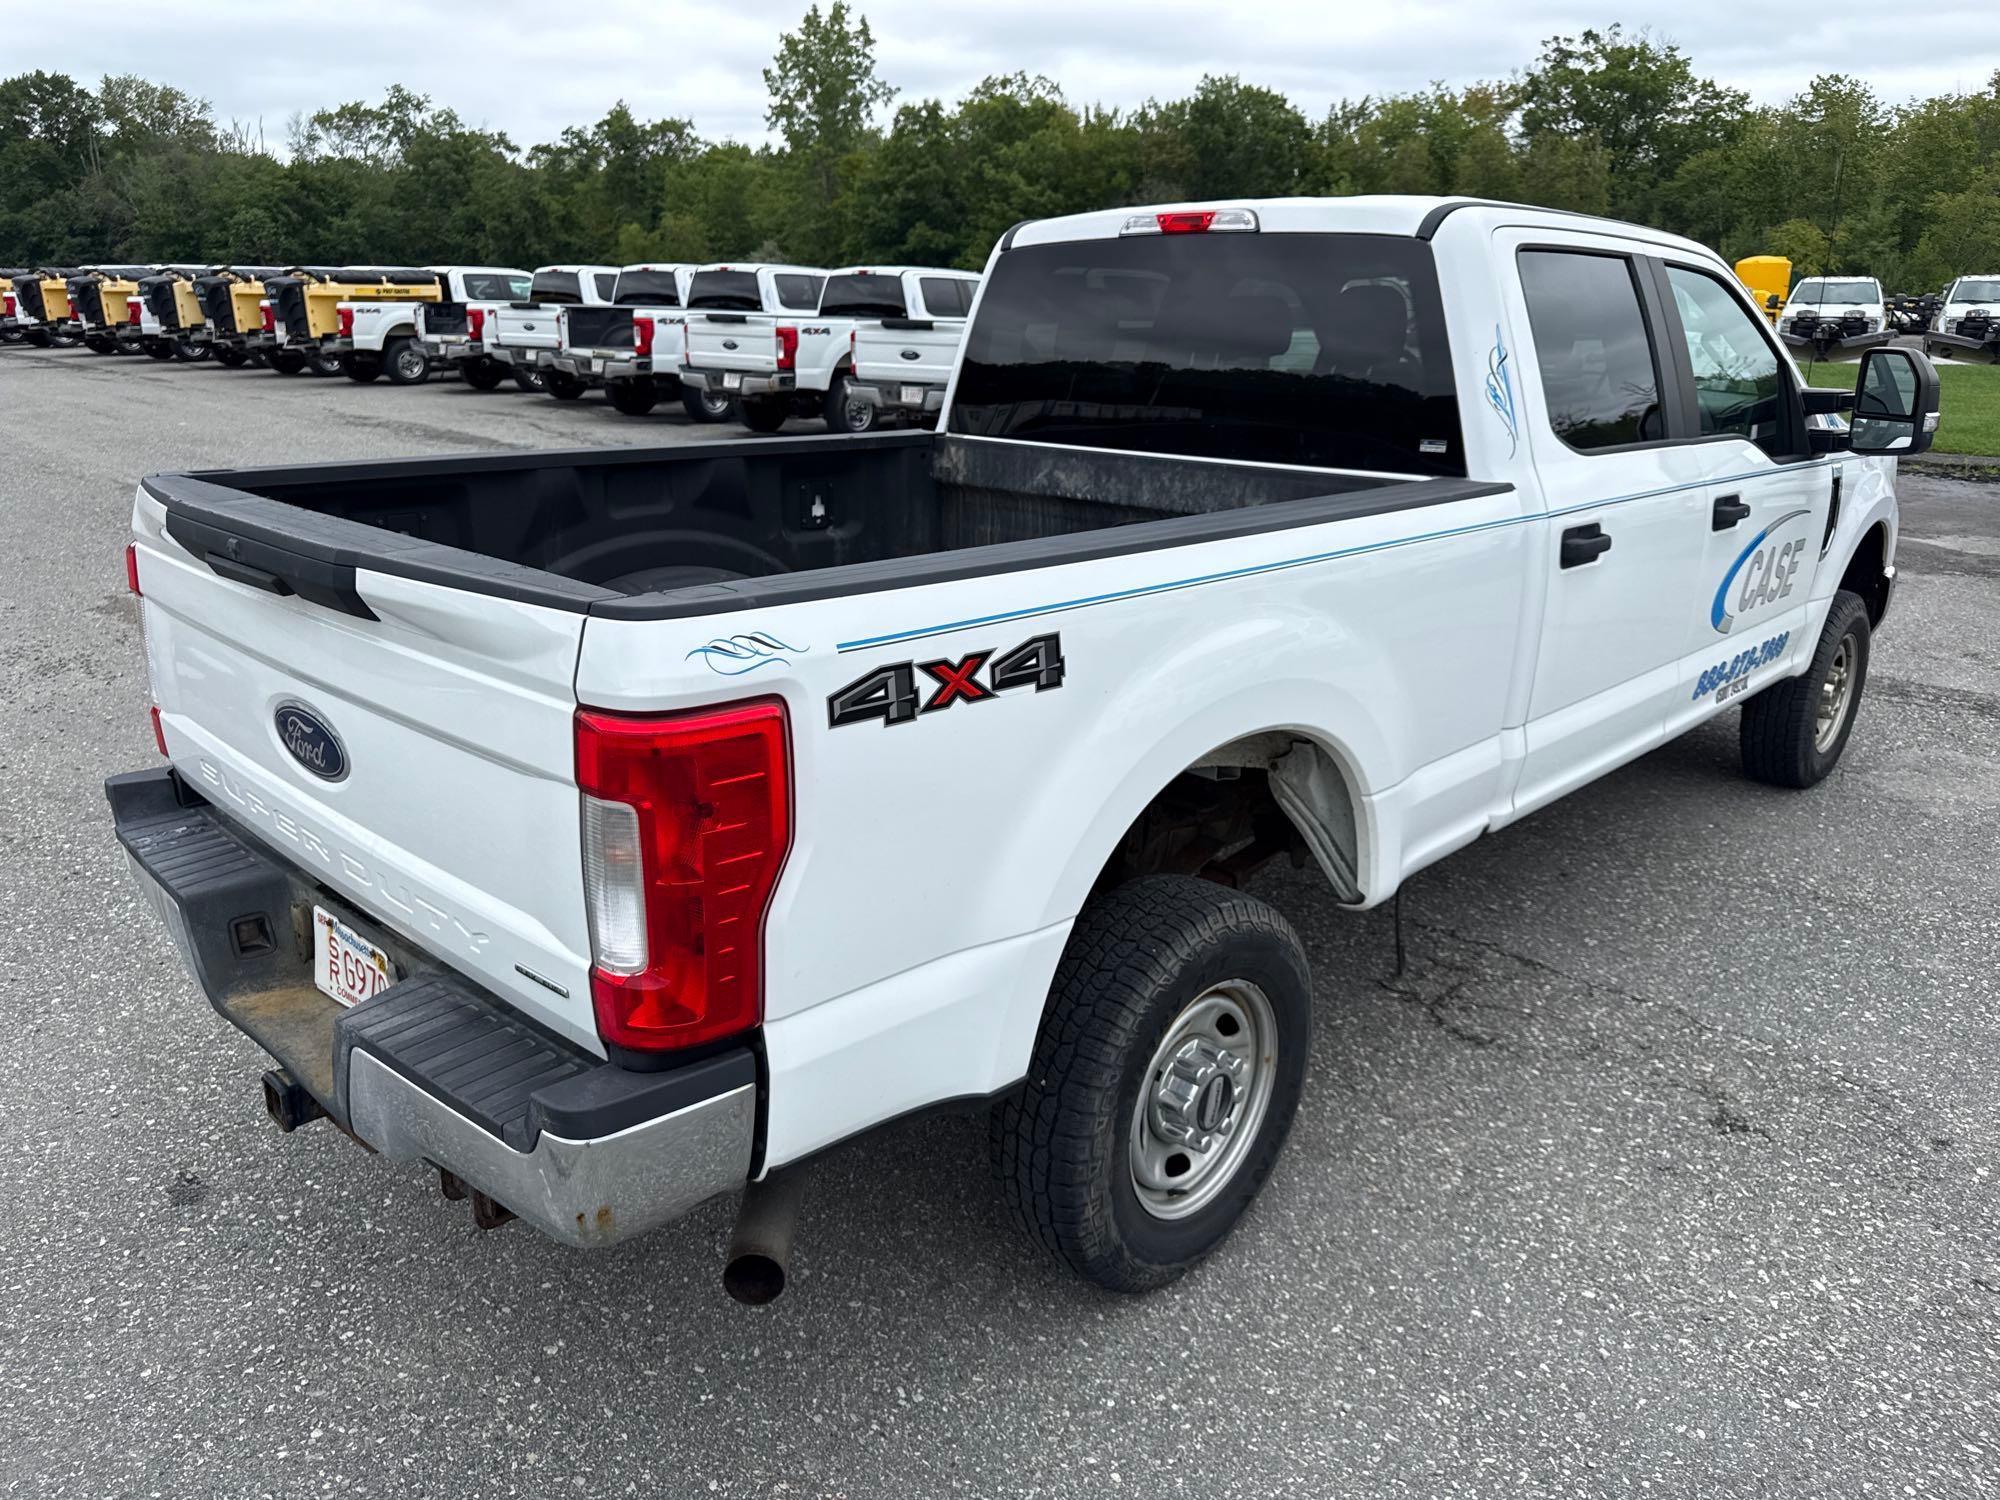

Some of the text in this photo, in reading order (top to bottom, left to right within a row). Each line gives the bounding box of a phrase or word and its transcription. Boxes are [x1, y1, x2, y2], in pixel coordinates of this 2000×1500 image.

[1738, 538, 1806, 612] CASE
[285, 715, 326, 768] Ford
[199, 756, 491, 955] SUPER DUTY
[336, 986, 362, 1005] COMME
